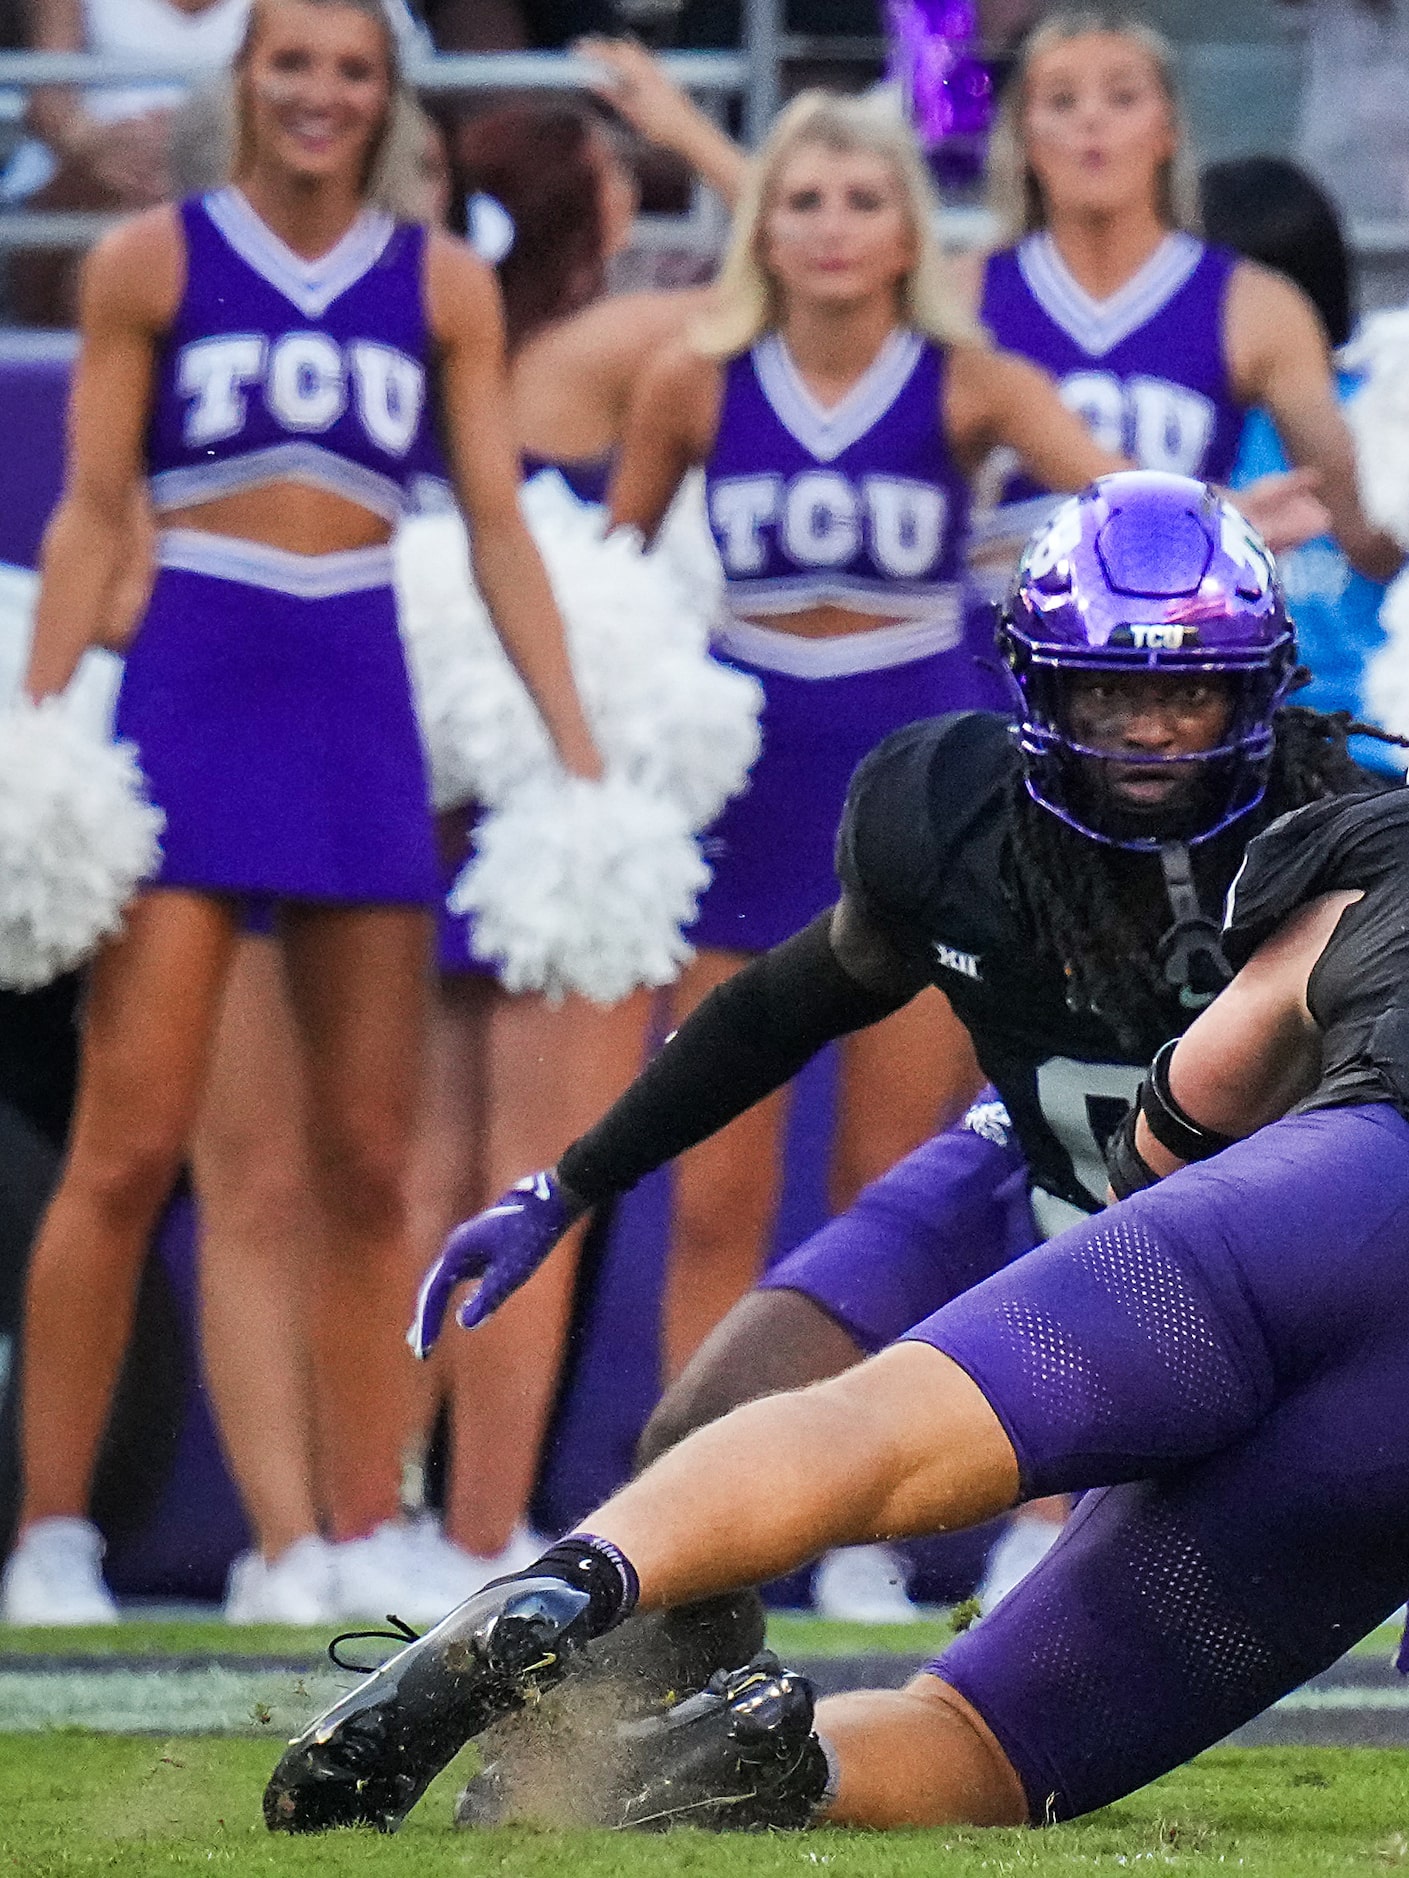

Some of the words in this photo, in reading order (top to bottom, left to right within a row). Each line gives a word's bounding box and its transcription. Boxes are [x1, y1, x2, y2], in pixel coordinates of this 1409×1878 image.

[177, 331, 425, 457] TCU
[708, 470, 948, 580] TCU
[1130, 624, 1184, 650] TCU
